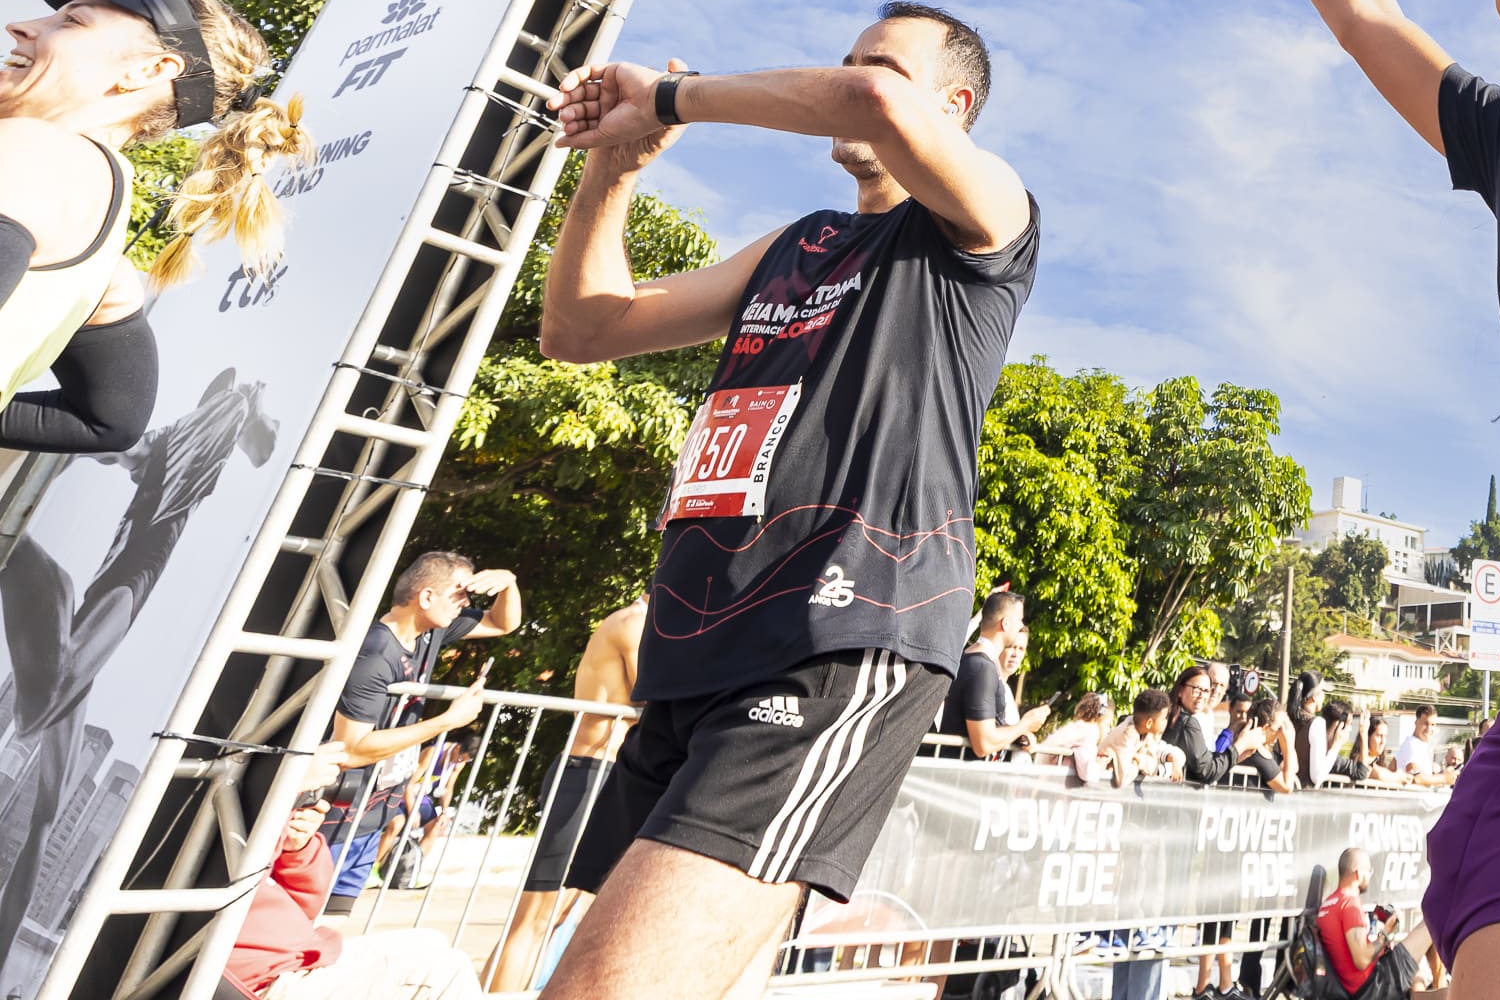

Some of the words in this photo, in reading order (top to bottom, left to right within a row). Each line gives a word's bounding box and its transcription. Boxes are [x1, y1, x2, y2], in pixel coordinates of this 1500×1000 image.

[339, 6, 442, 67] parmalat
[753, 414, 787, 483] BRANCO
[819, 565, 855, 608] 25
[1484, 572, 1496, 595] E
[748, 706, 805, 728] adidas
[974, 799, 1124, 852] POWER
[1197, 807, 1298, 852] POWER
[1349, 813, 1424, 852] POWER
[1038, 853, 1119, 908] ADE
[1240, 852, 1296, 898] ADE
[1380, 852, 1421, 891] ADE
